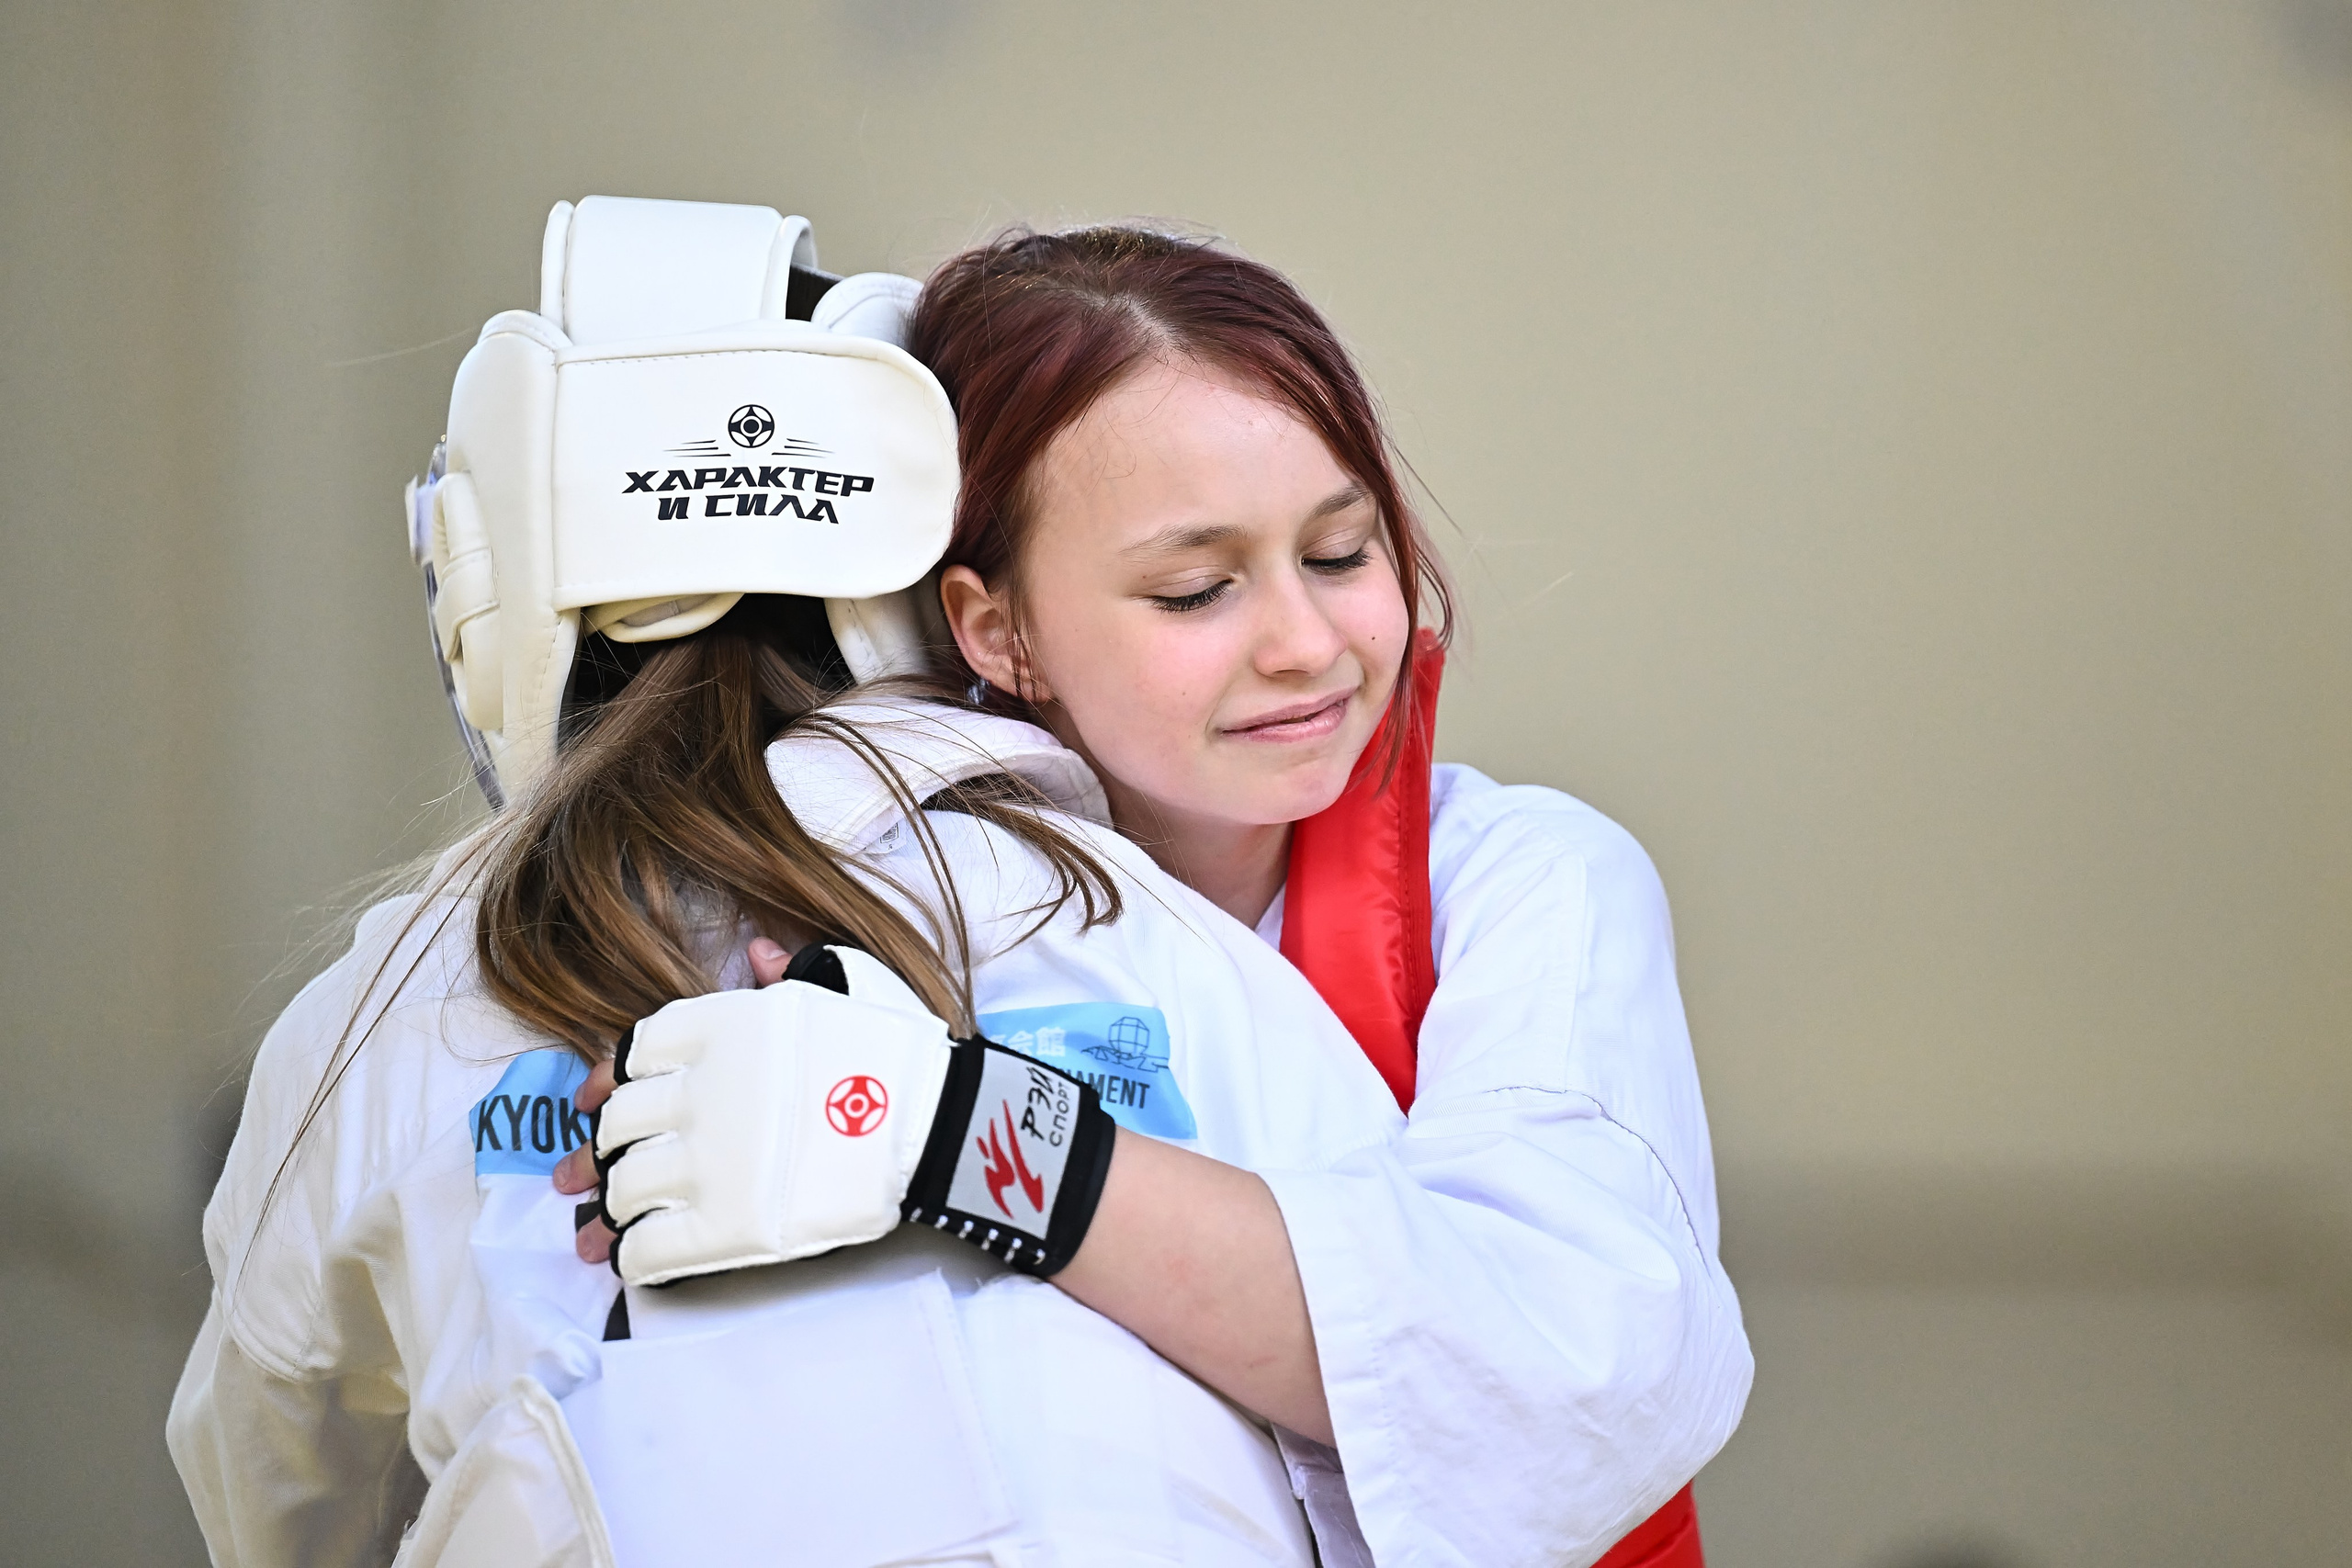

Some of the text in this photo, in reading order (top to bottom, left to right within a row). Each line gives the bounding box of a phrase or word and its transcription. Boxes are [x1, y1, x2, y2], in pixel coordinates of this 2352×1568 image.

[621, 466, 875, 497] ХАРАКТЕР
[657, 493, 839, 525] И СИЛА
[988, 1026, 1066, 1056] 会館
[1048, 1080, 1072, 1147] СПОРТ
